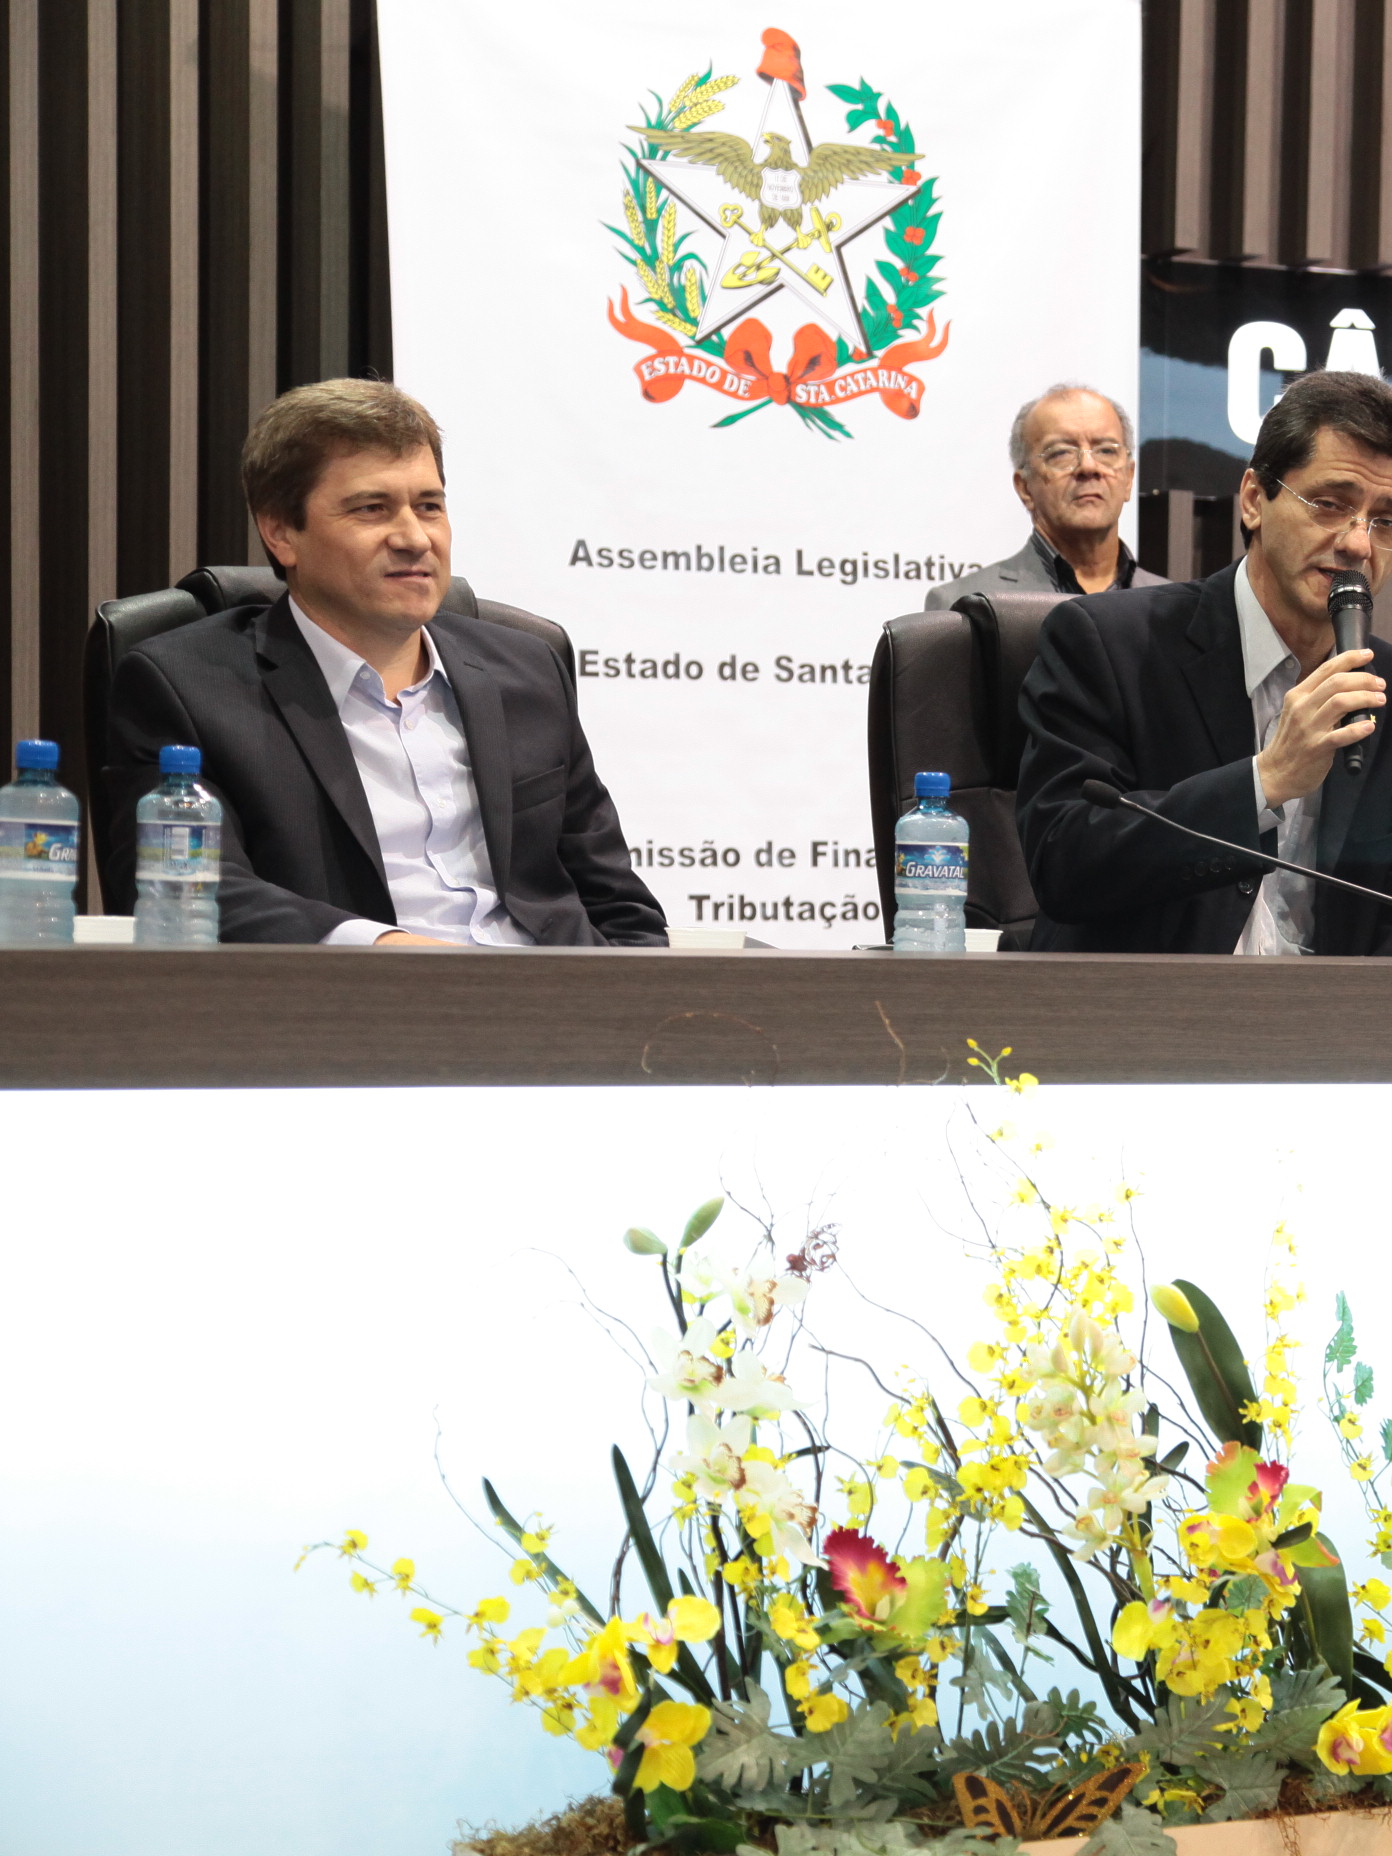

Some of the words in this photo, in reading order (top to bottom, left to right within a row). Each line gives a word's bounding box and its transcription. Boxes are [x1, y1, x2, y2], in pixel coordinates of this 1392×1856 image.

[642, 356, 720, 384] ESTADO
[724, 374, 751, 398] DE
[795, 382, 836, 404] STA.
[835, 369, 919, 399] CATARINA
[568, 539, 782, 575] Assembleia
[578, 650, 704, 681] Estado
[718, 655, 760, 682] de
[774, 655, 871, 685] Santa
[755, 840, 796, 868] de
[688, 894, 880, 929] Tributação
